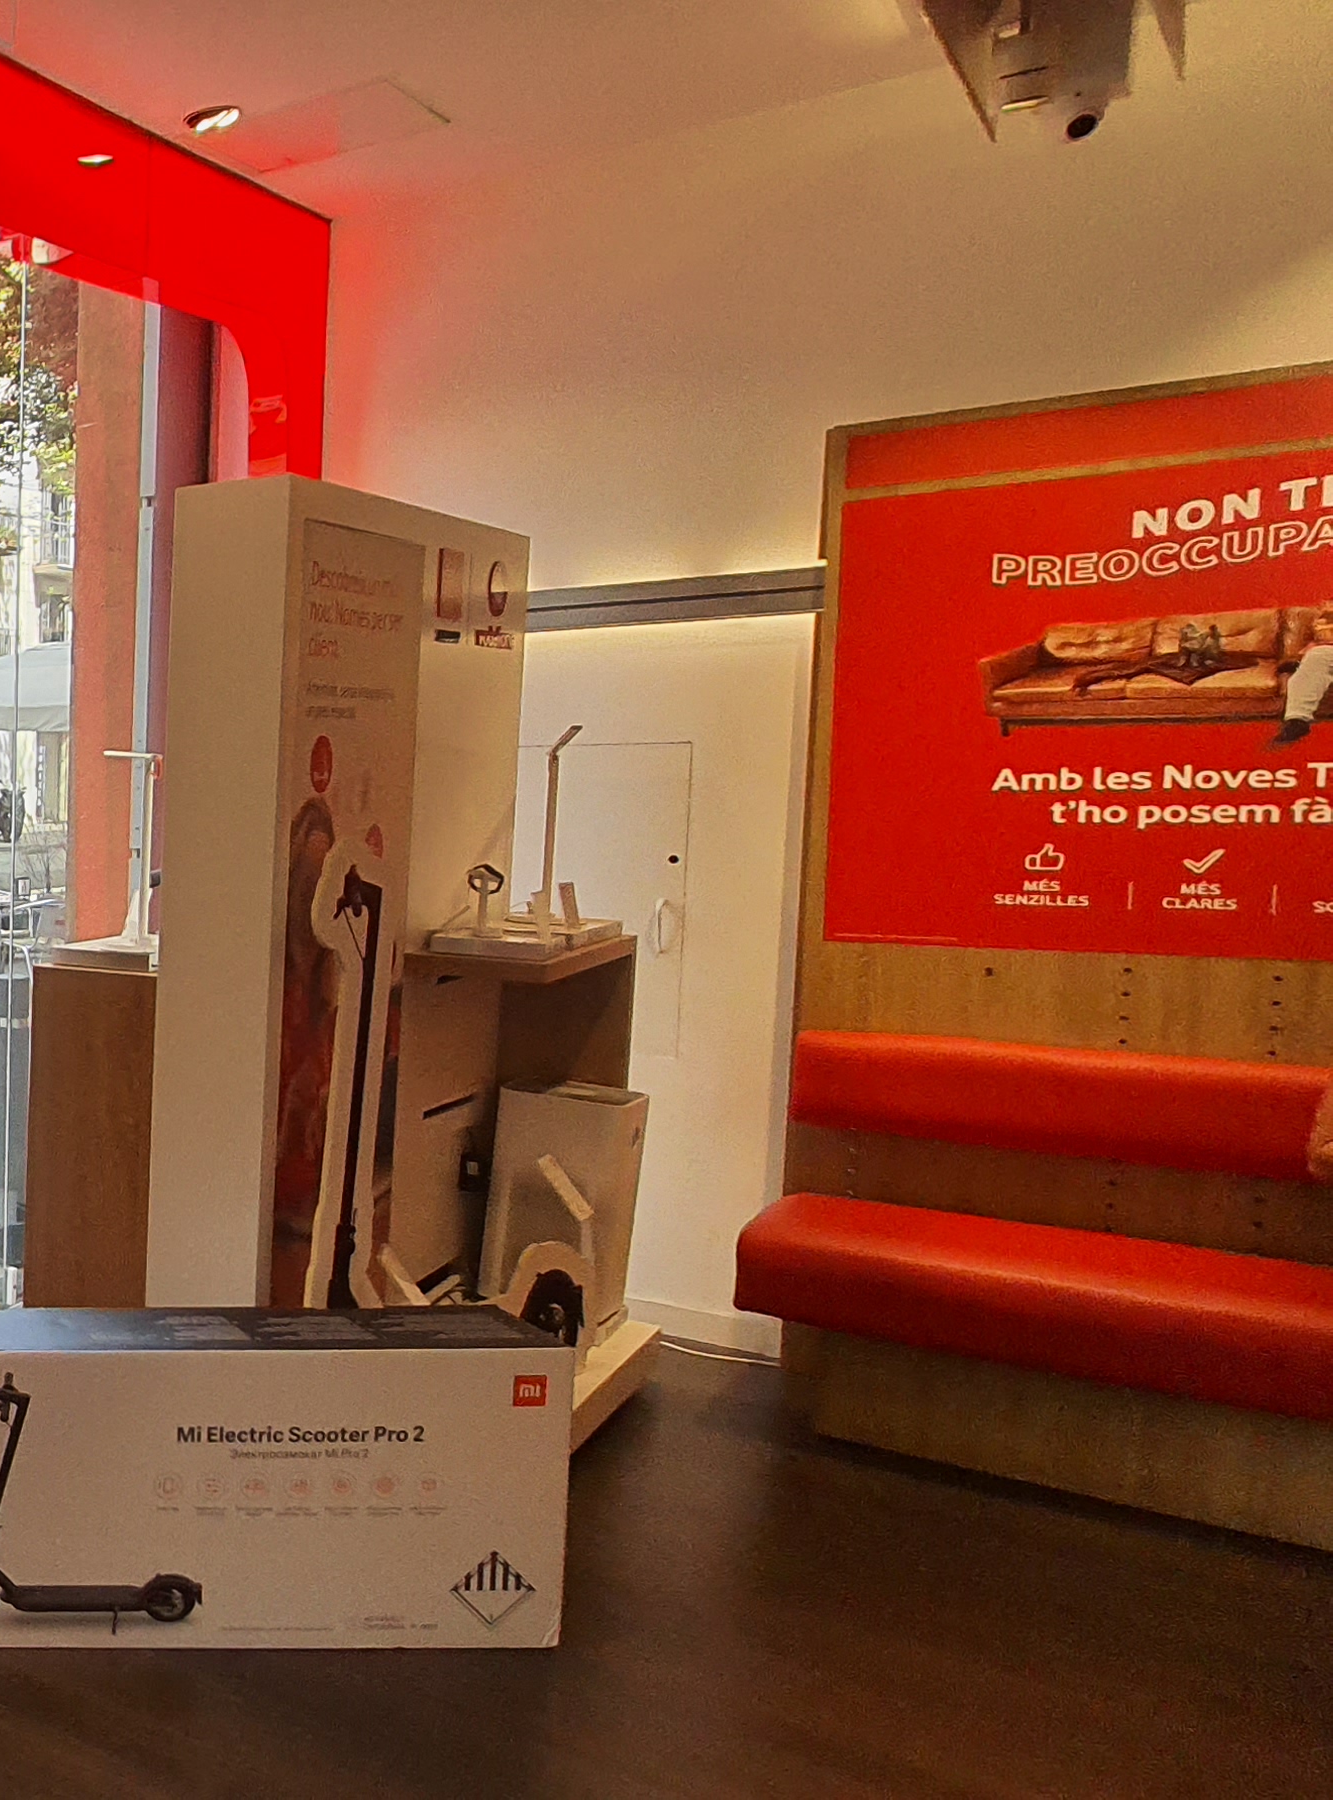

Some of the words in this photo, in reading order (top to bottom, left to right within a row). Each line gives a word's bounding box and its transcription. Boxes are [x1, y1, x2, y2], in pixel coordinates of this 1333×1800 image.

[1131, 487, 1261, 539] NON
[991, 767, 1083, 792] Amb
[1093, 766, 1153, 791] les
[1162, 764, 1298, 790] Noves
[1136, 802, 1280, 830] posem
[1022, 878, 1060, 892] MÉS
[1180, 881, 1221, 895] MÉS
[992, 893, 1089, 907] SENZILLES
[1161, 897, 1238, 911] CLARES
[176, 1426, 202, 1443] Mi
[207, 1426, 284, 1444] Electric
[288, 1426, 370, 1444] Scooter
[373, 1426, 409, 1444] Pro
[413, 1426, 425, 1443] 2
